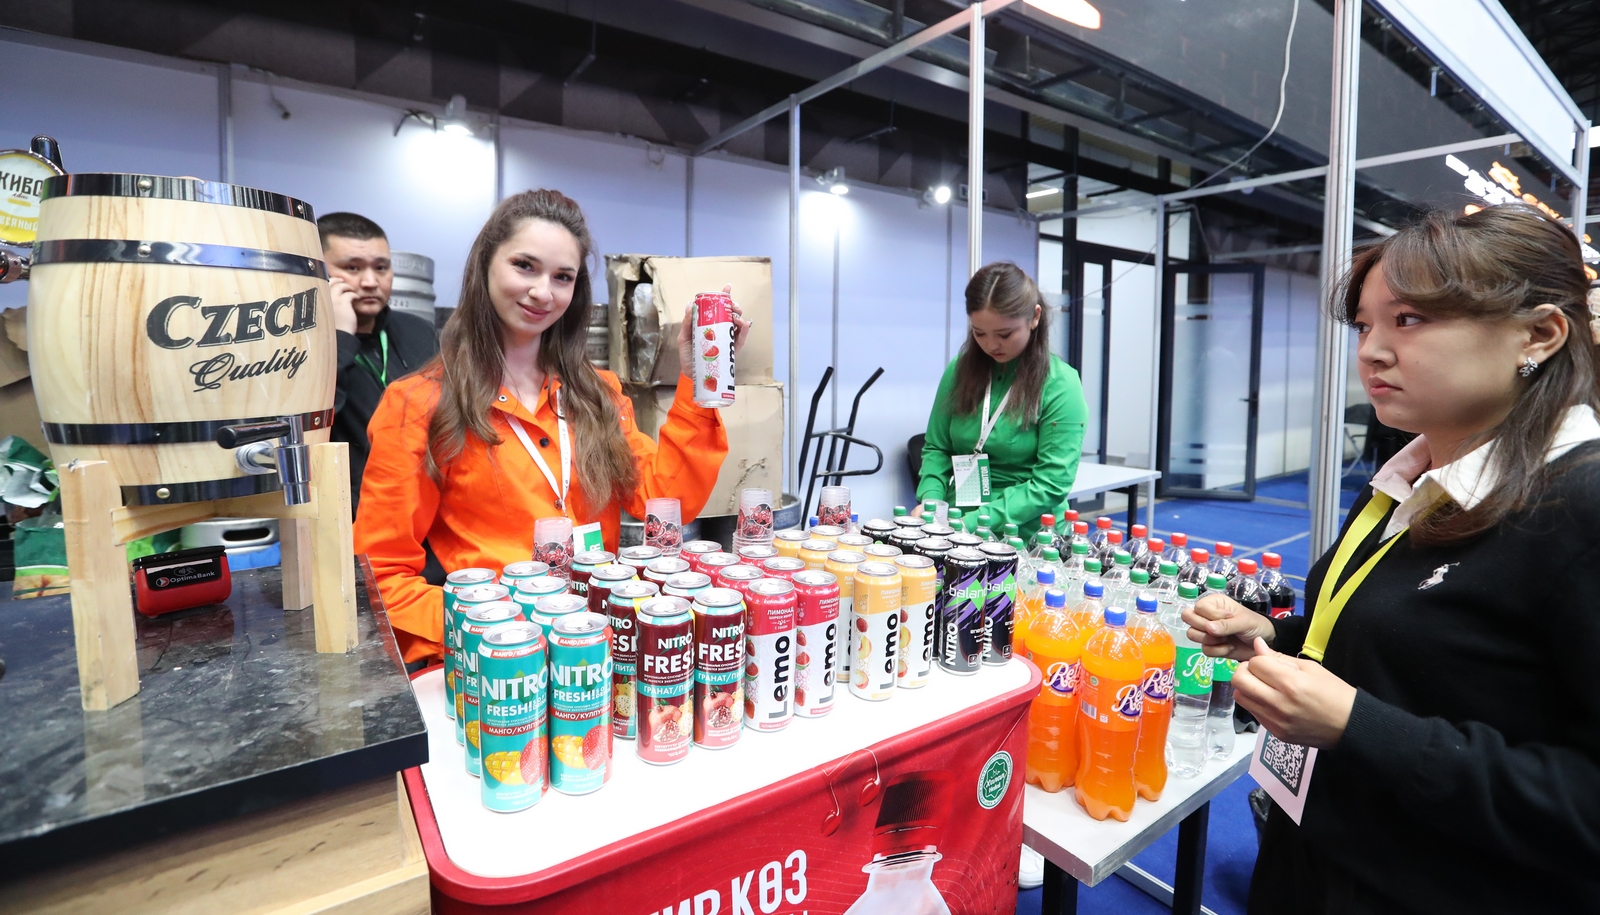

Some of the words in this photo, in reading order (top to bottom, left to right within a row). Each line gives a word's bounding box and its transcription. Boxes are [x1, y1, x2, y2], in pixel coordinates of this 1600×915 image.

[146, 287, 318, 349] CZECH
[189, 347, 307, 392] Quality
[170, 571, 215, 583] OptimaBank
[658, 633, 693, 649] NITRO
[712, 623, 745, 638] NITRO
[918, 603, 934, 677] Lemo
[945, 623, 958, 665] NITRO
[819, 623, 837, 704] Lemo
[880, 613, 898, 690] Lemo
[481, 665, 548, 700] NITRO
[550, 656, 613, 687] NITRO
[769, 636, 790, 718] Lemo
[486, 700, 532, 717] FRESH!
[553, 689, 595, 703] FRESH!
